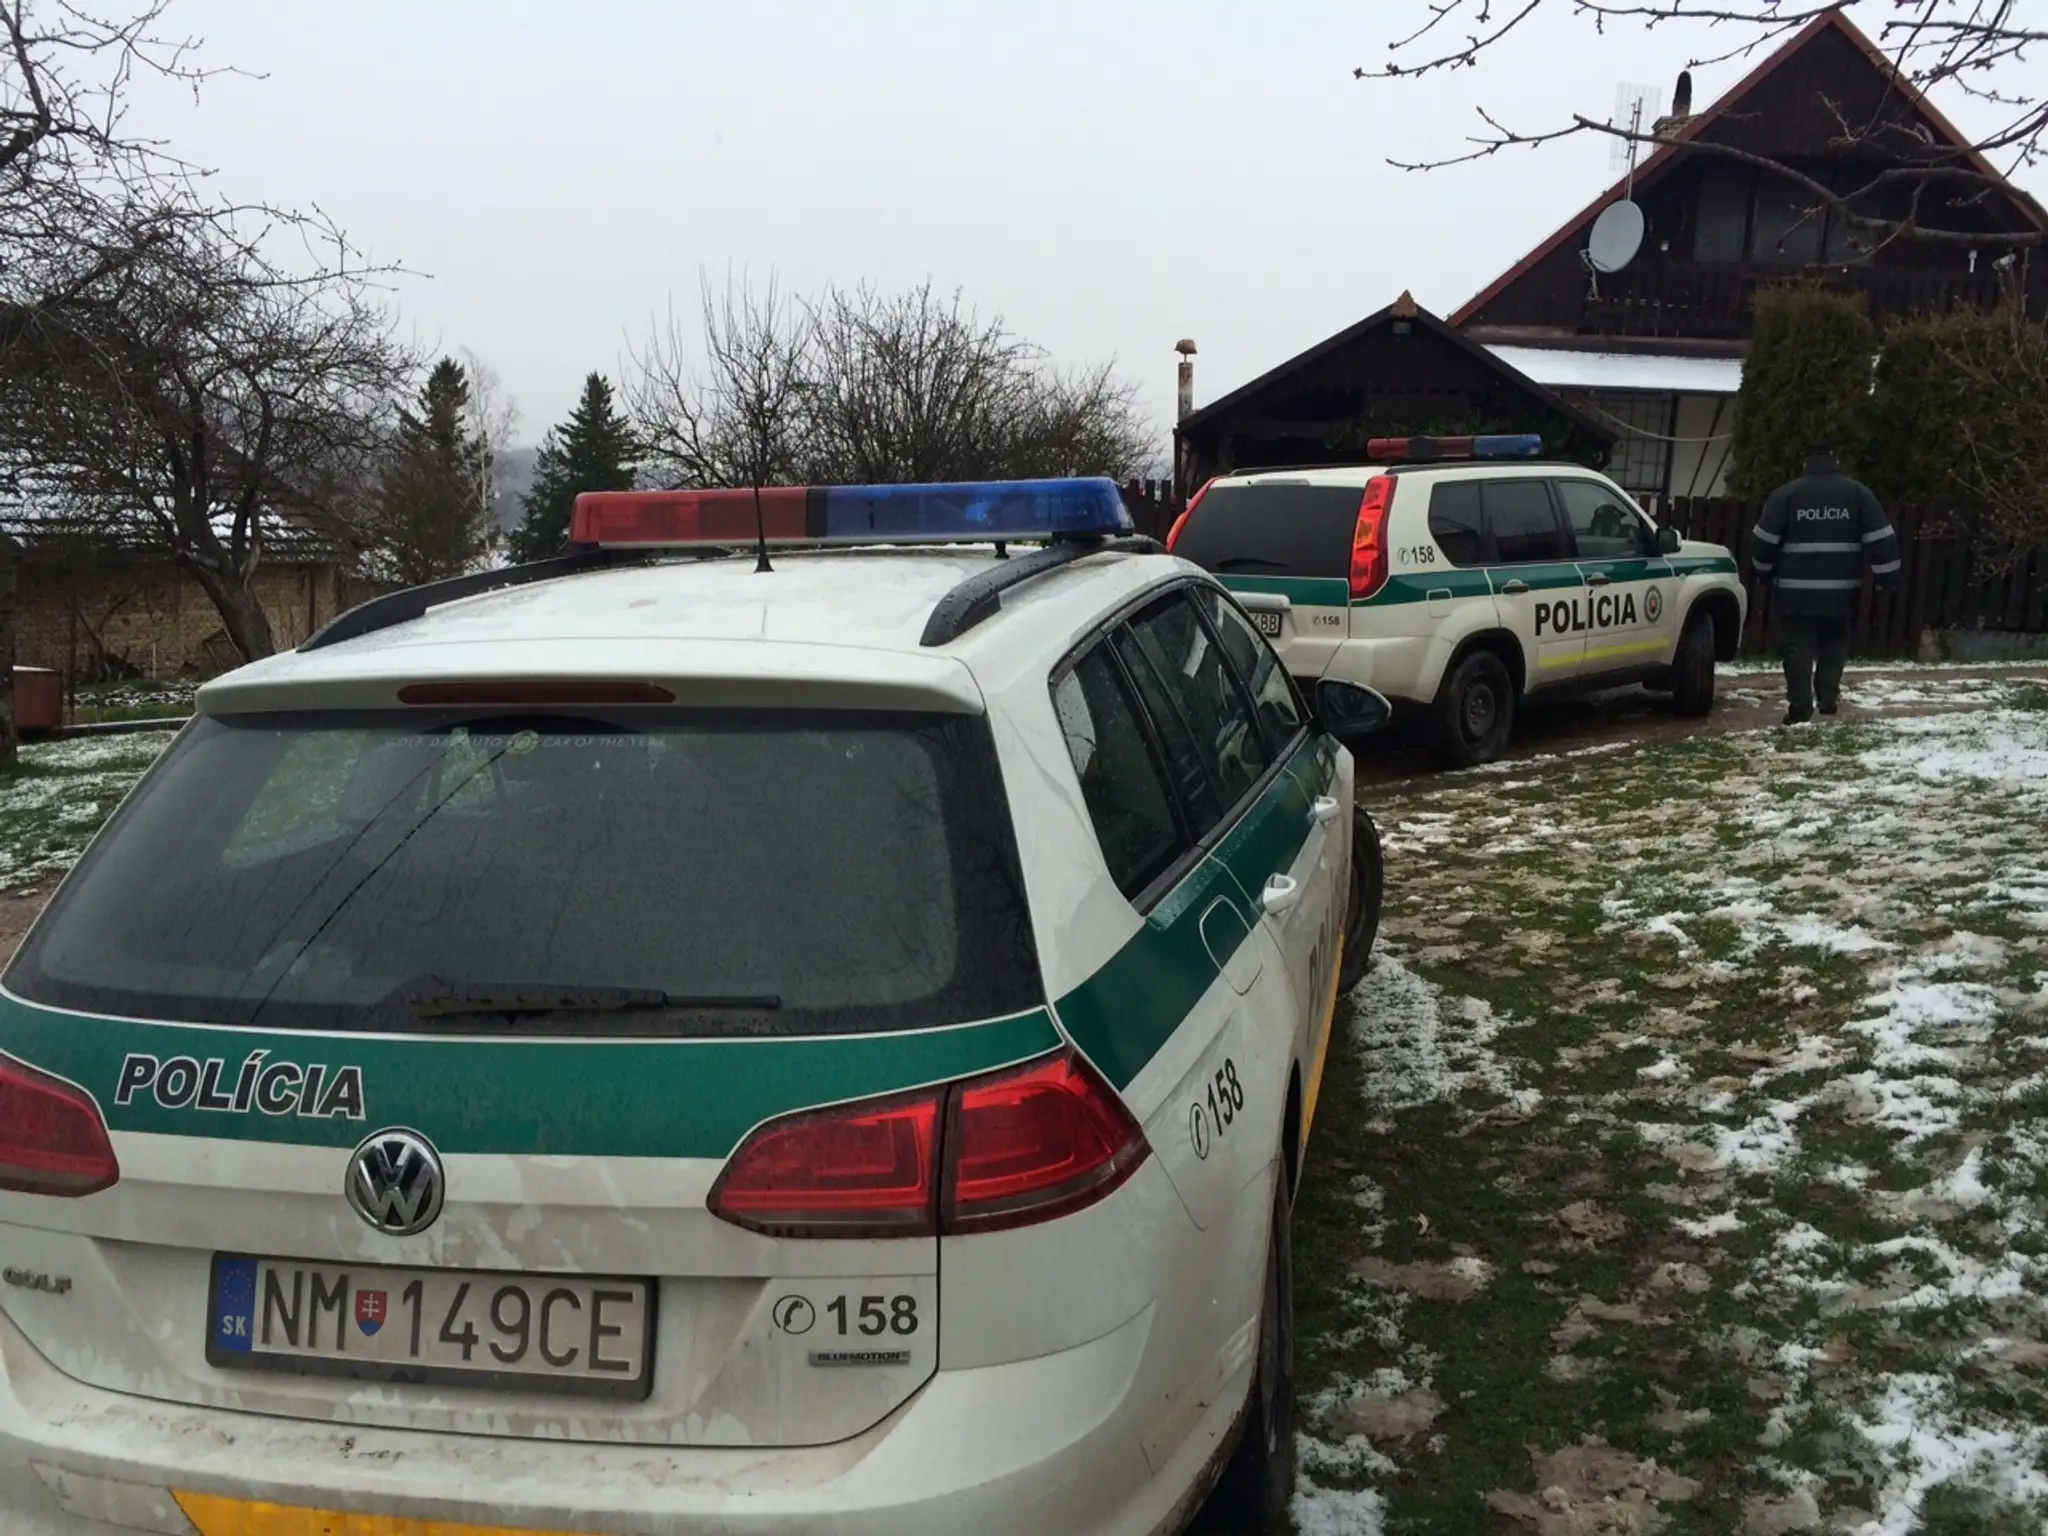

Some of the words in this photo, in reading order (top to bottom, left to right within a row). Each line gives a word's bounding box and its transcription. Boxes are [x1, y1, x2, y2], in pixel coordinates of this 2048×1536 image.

[1797, 506, 1849, 521] POLÍCIA
[1411, 545, 1435, 565] 158
[1322, 615, 1340, 626] 158
[1535, 589, 1637, 637] POLÍCIA
[115, 1050, 366, 1120] POLÍCIA
[1207, 1057, 1244, 1136] 158
[2, 1266, 72, 1294] GOLF
[221, 1314, 247, 1336] SK
[261, 1269, 348, 1350] NM
[402, 1280, 634, 1372] 149CE
[826, 1295, 919, 1336] 158
